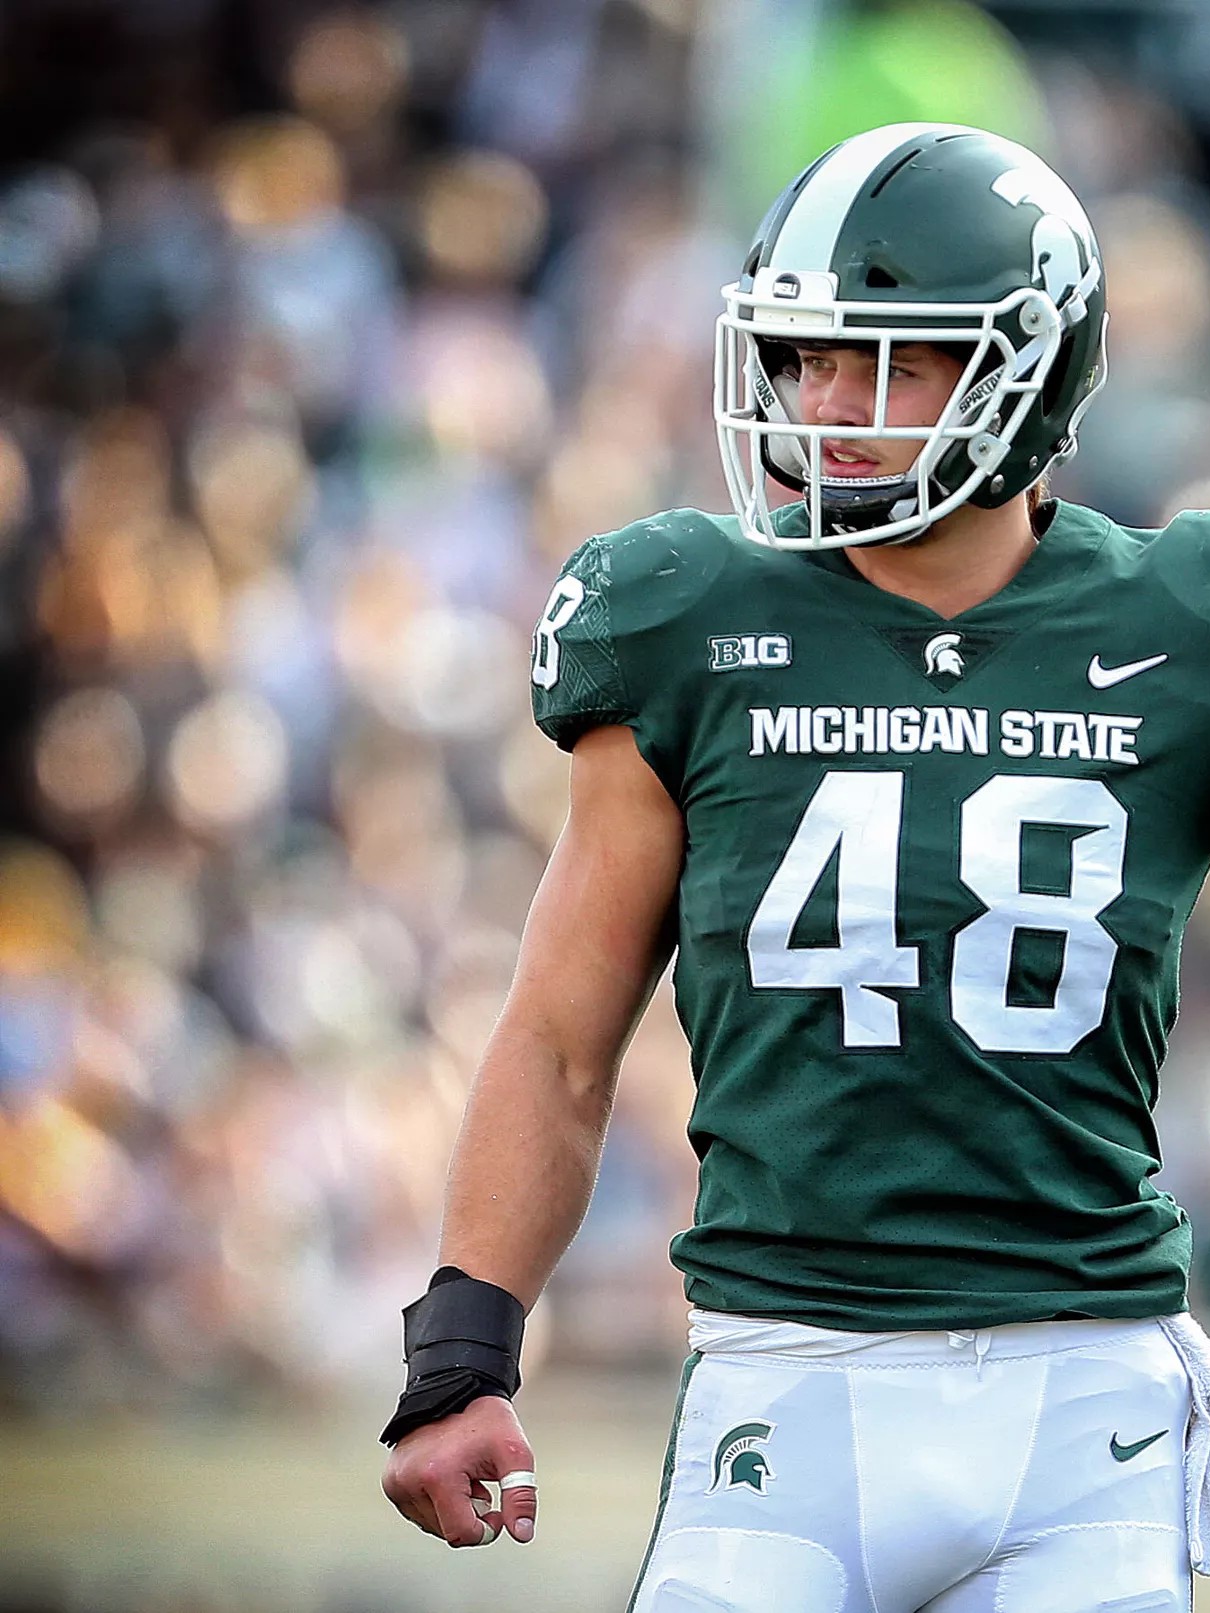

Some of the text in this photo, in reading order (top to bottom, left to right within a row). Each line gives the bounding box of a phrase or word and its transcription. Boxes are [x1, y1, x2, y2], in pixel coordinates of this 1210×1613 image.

[532, 574, 585, 691] 8
[748, 706, 1143, 766] MICHIGAN STATE
[746, 770, 1129, 1054] 48
